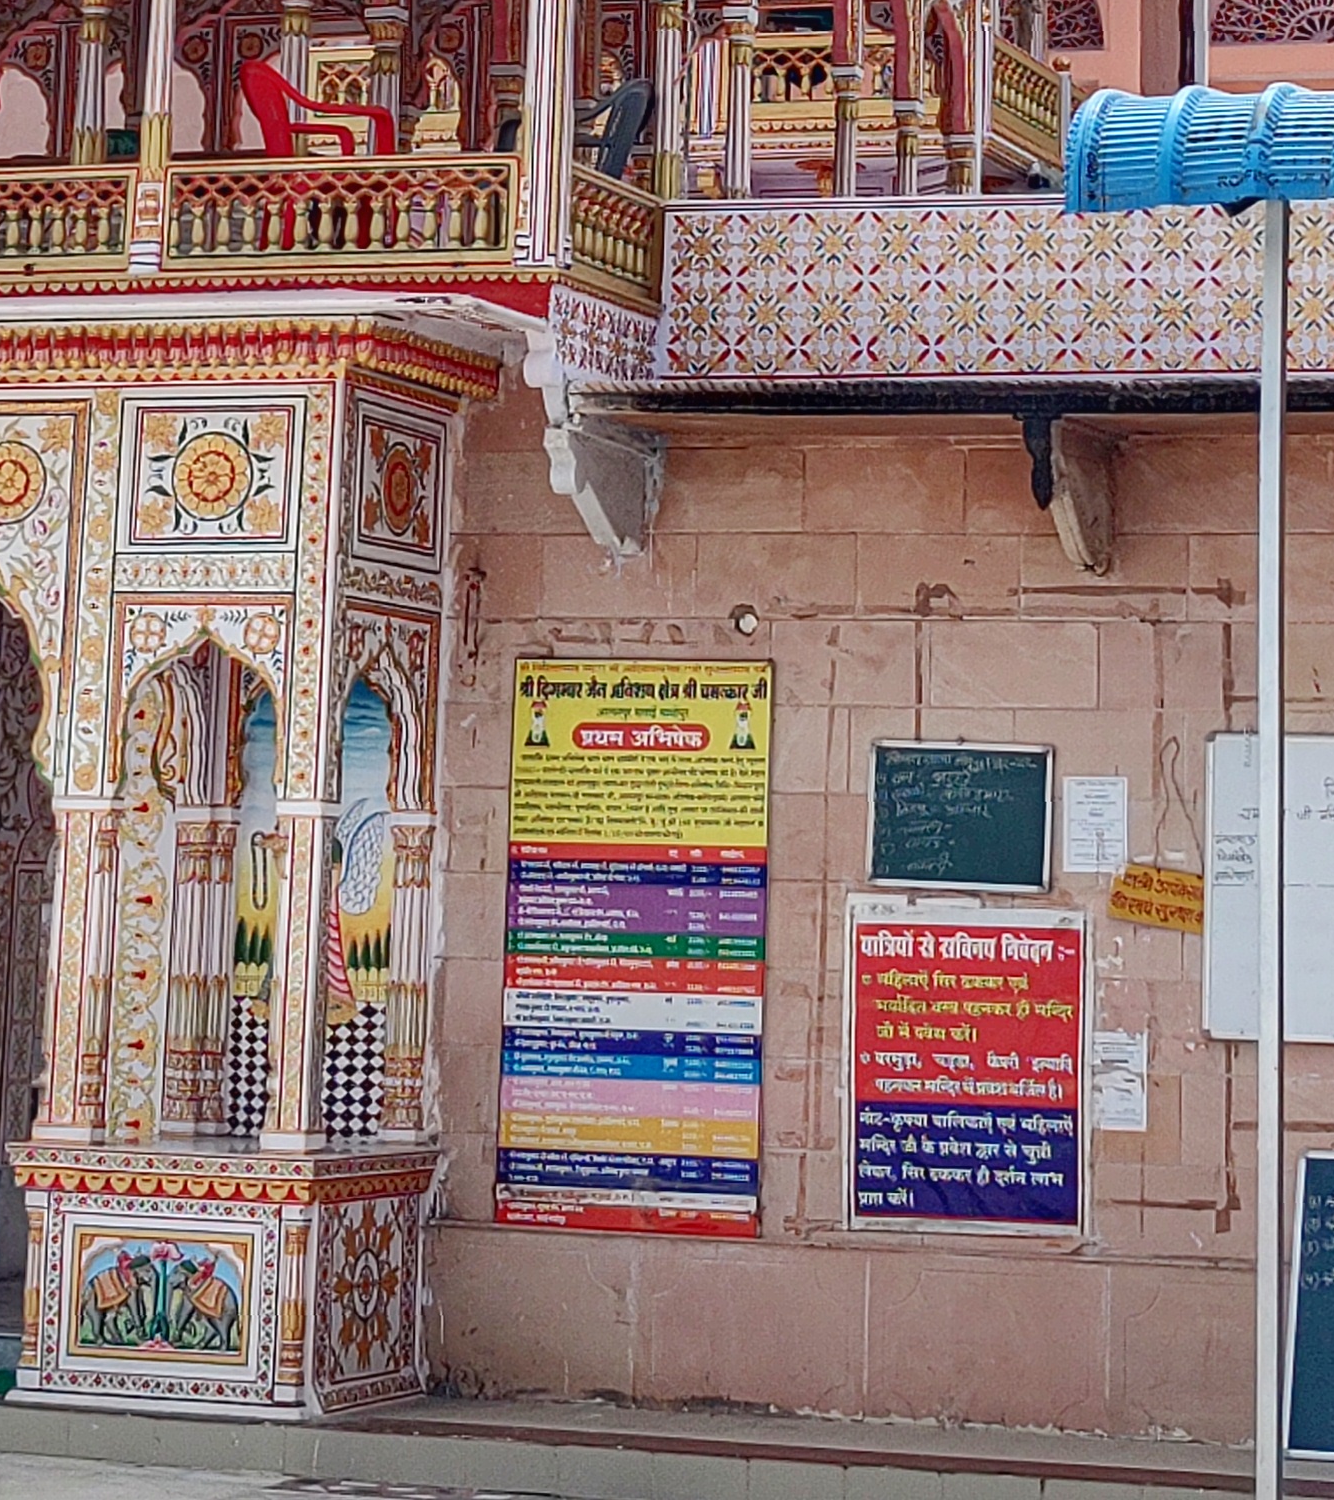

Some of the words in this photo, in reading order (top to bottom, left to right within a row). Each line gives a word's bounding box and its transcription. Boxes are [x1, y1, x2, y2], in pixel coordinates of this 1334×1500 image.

[519, 674, 534, 698] श्री
[585, 674, 607, 699] जैन
[751, 676, 768, 699] जी
[580, 729, 624, 747] प्रथम
[630, 724, 703, 748] अभिषेक
[860, 929, 915, 957] यात्रियों
[916, 931, 935, 958] से
[938, 931, 998, 960] सविनय
[1001, 932, 1054, 966] निवेदन
[859, 1133, 897, 1156] मन्दिर
[938, 1136, 972, 1157] प्रवेश
